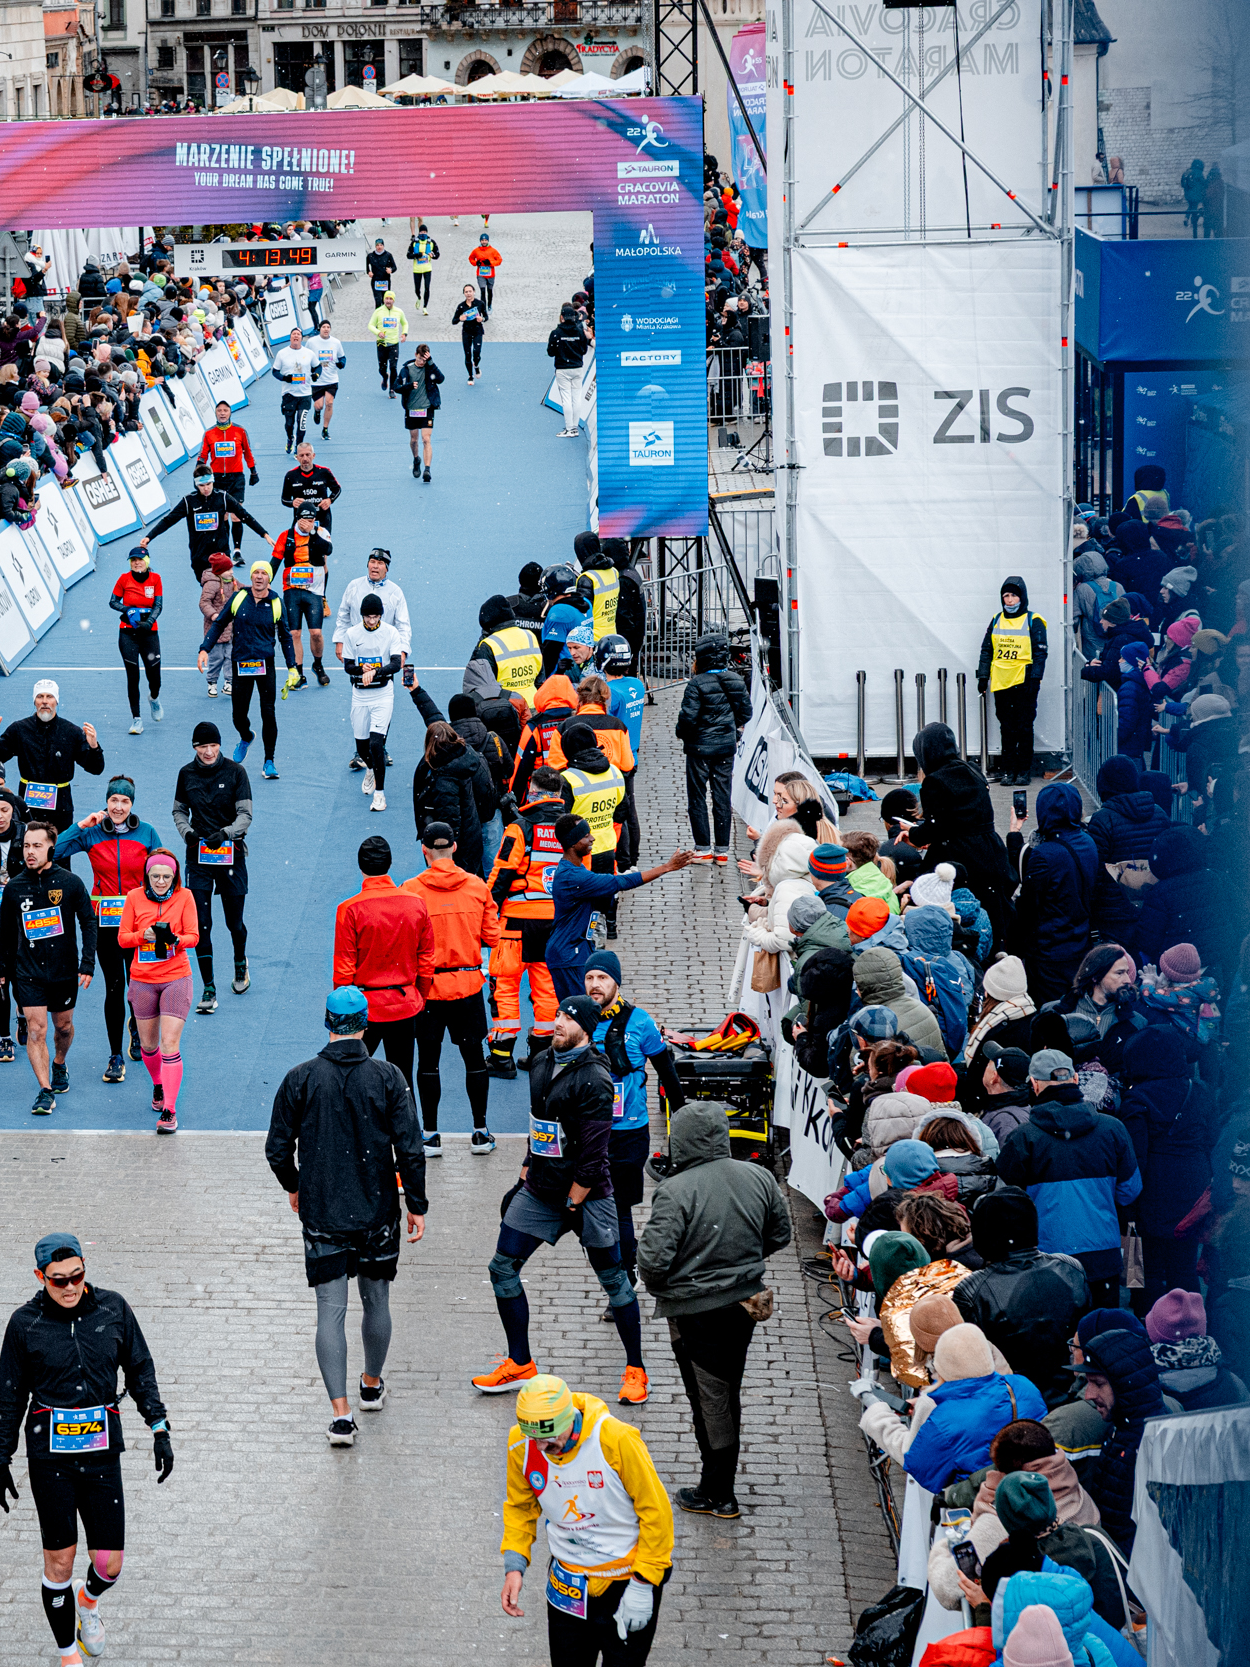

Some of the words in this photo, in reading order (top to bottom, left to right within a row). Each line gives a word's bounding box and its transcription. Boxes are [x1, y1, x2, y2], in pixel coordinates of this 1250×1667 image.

[302, 24, 330, 38] DOM
[337, 23, 387, 38] POLONII
[627, 128, 641, 136] 22
[175, 142, 254, 170] MARZENIE
[261, 146, 355, 174] SPEŁNIONE!
[637, 165, 674, 173] TAURON
[194, 172, 219, 187] YOUR
[222, 173, 253, 188] DREAM
[256, 175, 276, 189] HAS
[279, 176, 304, 191] COME
[307, 177, 334, 192] TRUE!
[617, 181, 680, 193] CRACOVIA
[618, 193, 679, 205] MARATON
[324, 251, 357, 259] GARMIN
[615, 246, 682, 256] MAŁOPOLSKA
[1175, 291, 1192, 301] 22
[269, 301, 288, 319] OSHEE
[636, 317, 679, 325] WODOCIĄGI
[933, 386, 1035, 444] ZIS
[632, 449, 672, 458] TAURON
[85, 476, 119, 506] OSHEE
[997, 649, 1018, 660] 248
[511, 665, 533, 679] BOSS
[28, 790, 53, 799] 5747
[591, 797, 616, 814] BOSS
[27, 916, 59, 929] 4852
[56, 1421, 103, 1436] 6374
[539, 1418, 555, 1434] 5
